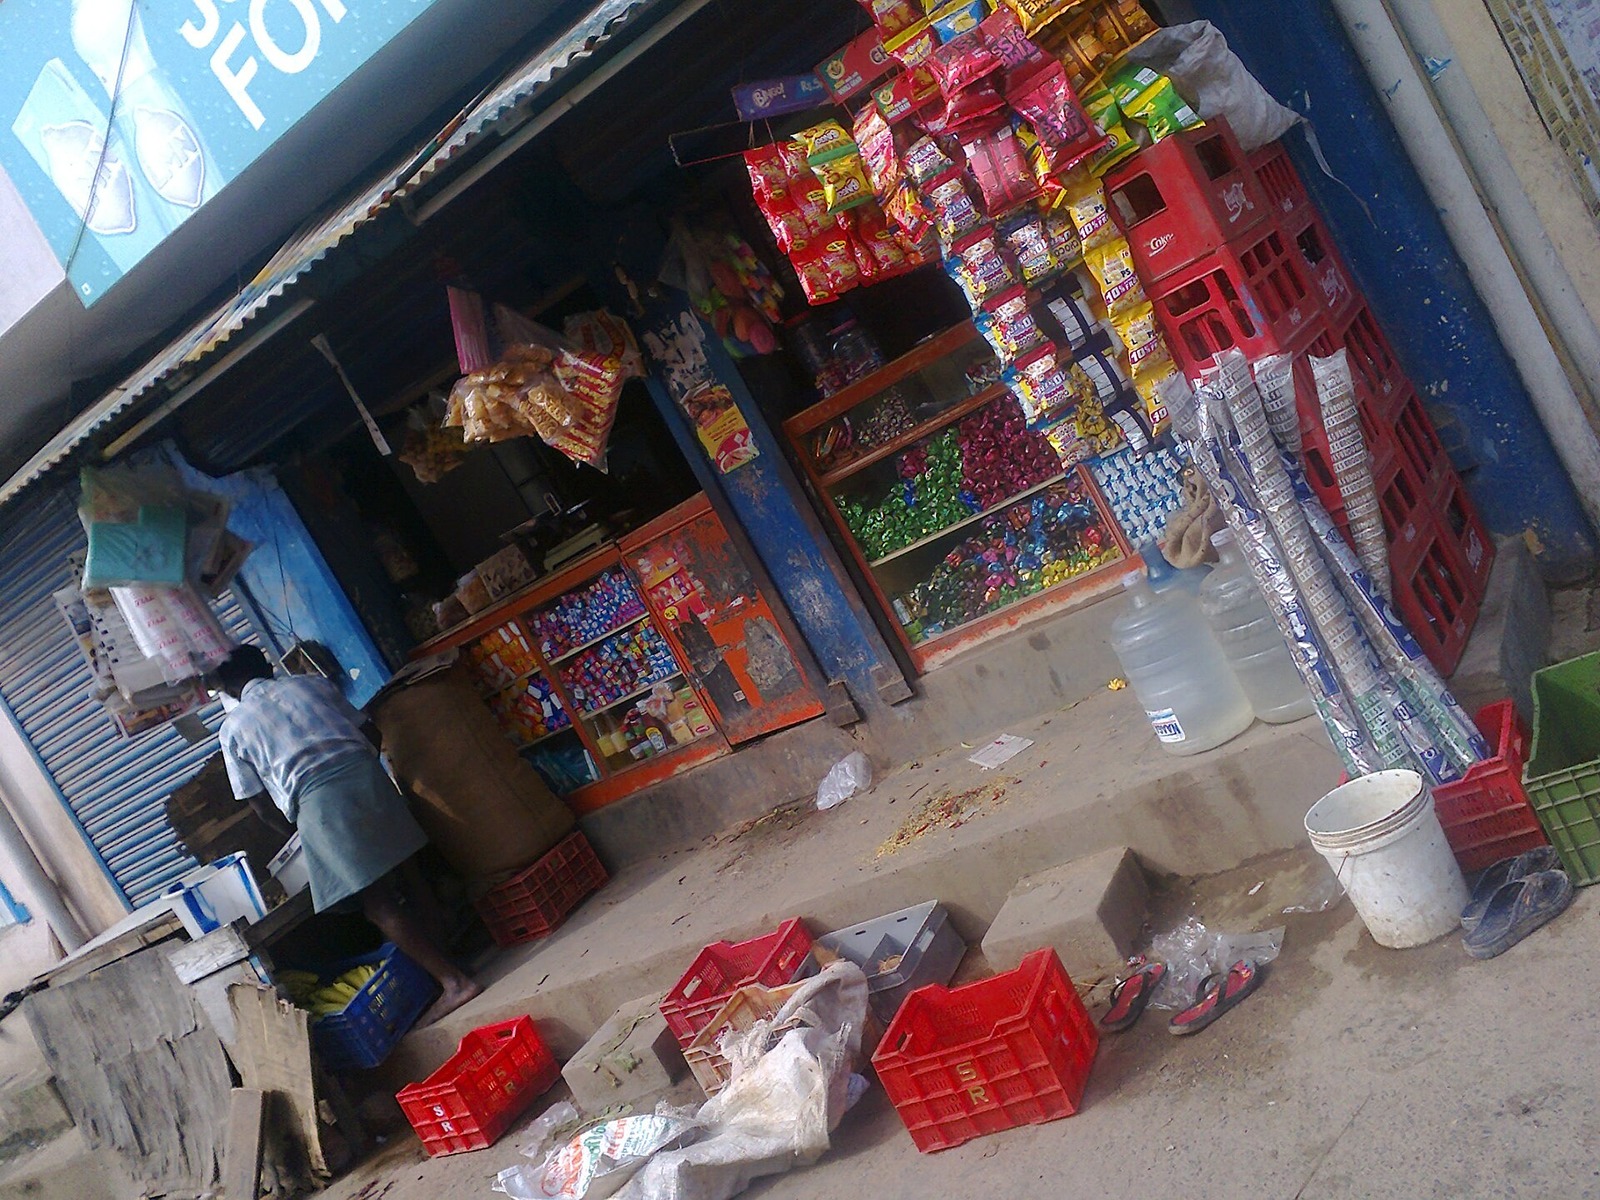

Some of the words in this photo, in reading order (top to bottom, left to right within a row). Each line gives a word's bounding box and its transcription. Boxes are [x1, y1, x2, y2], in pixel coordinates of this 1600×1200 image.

[955, 1061, 977, 1083] S
[967, 1085, 990, 1106] R
[432, 1105, 445, 1117] S
[440, 1121, 454, 1133] R
